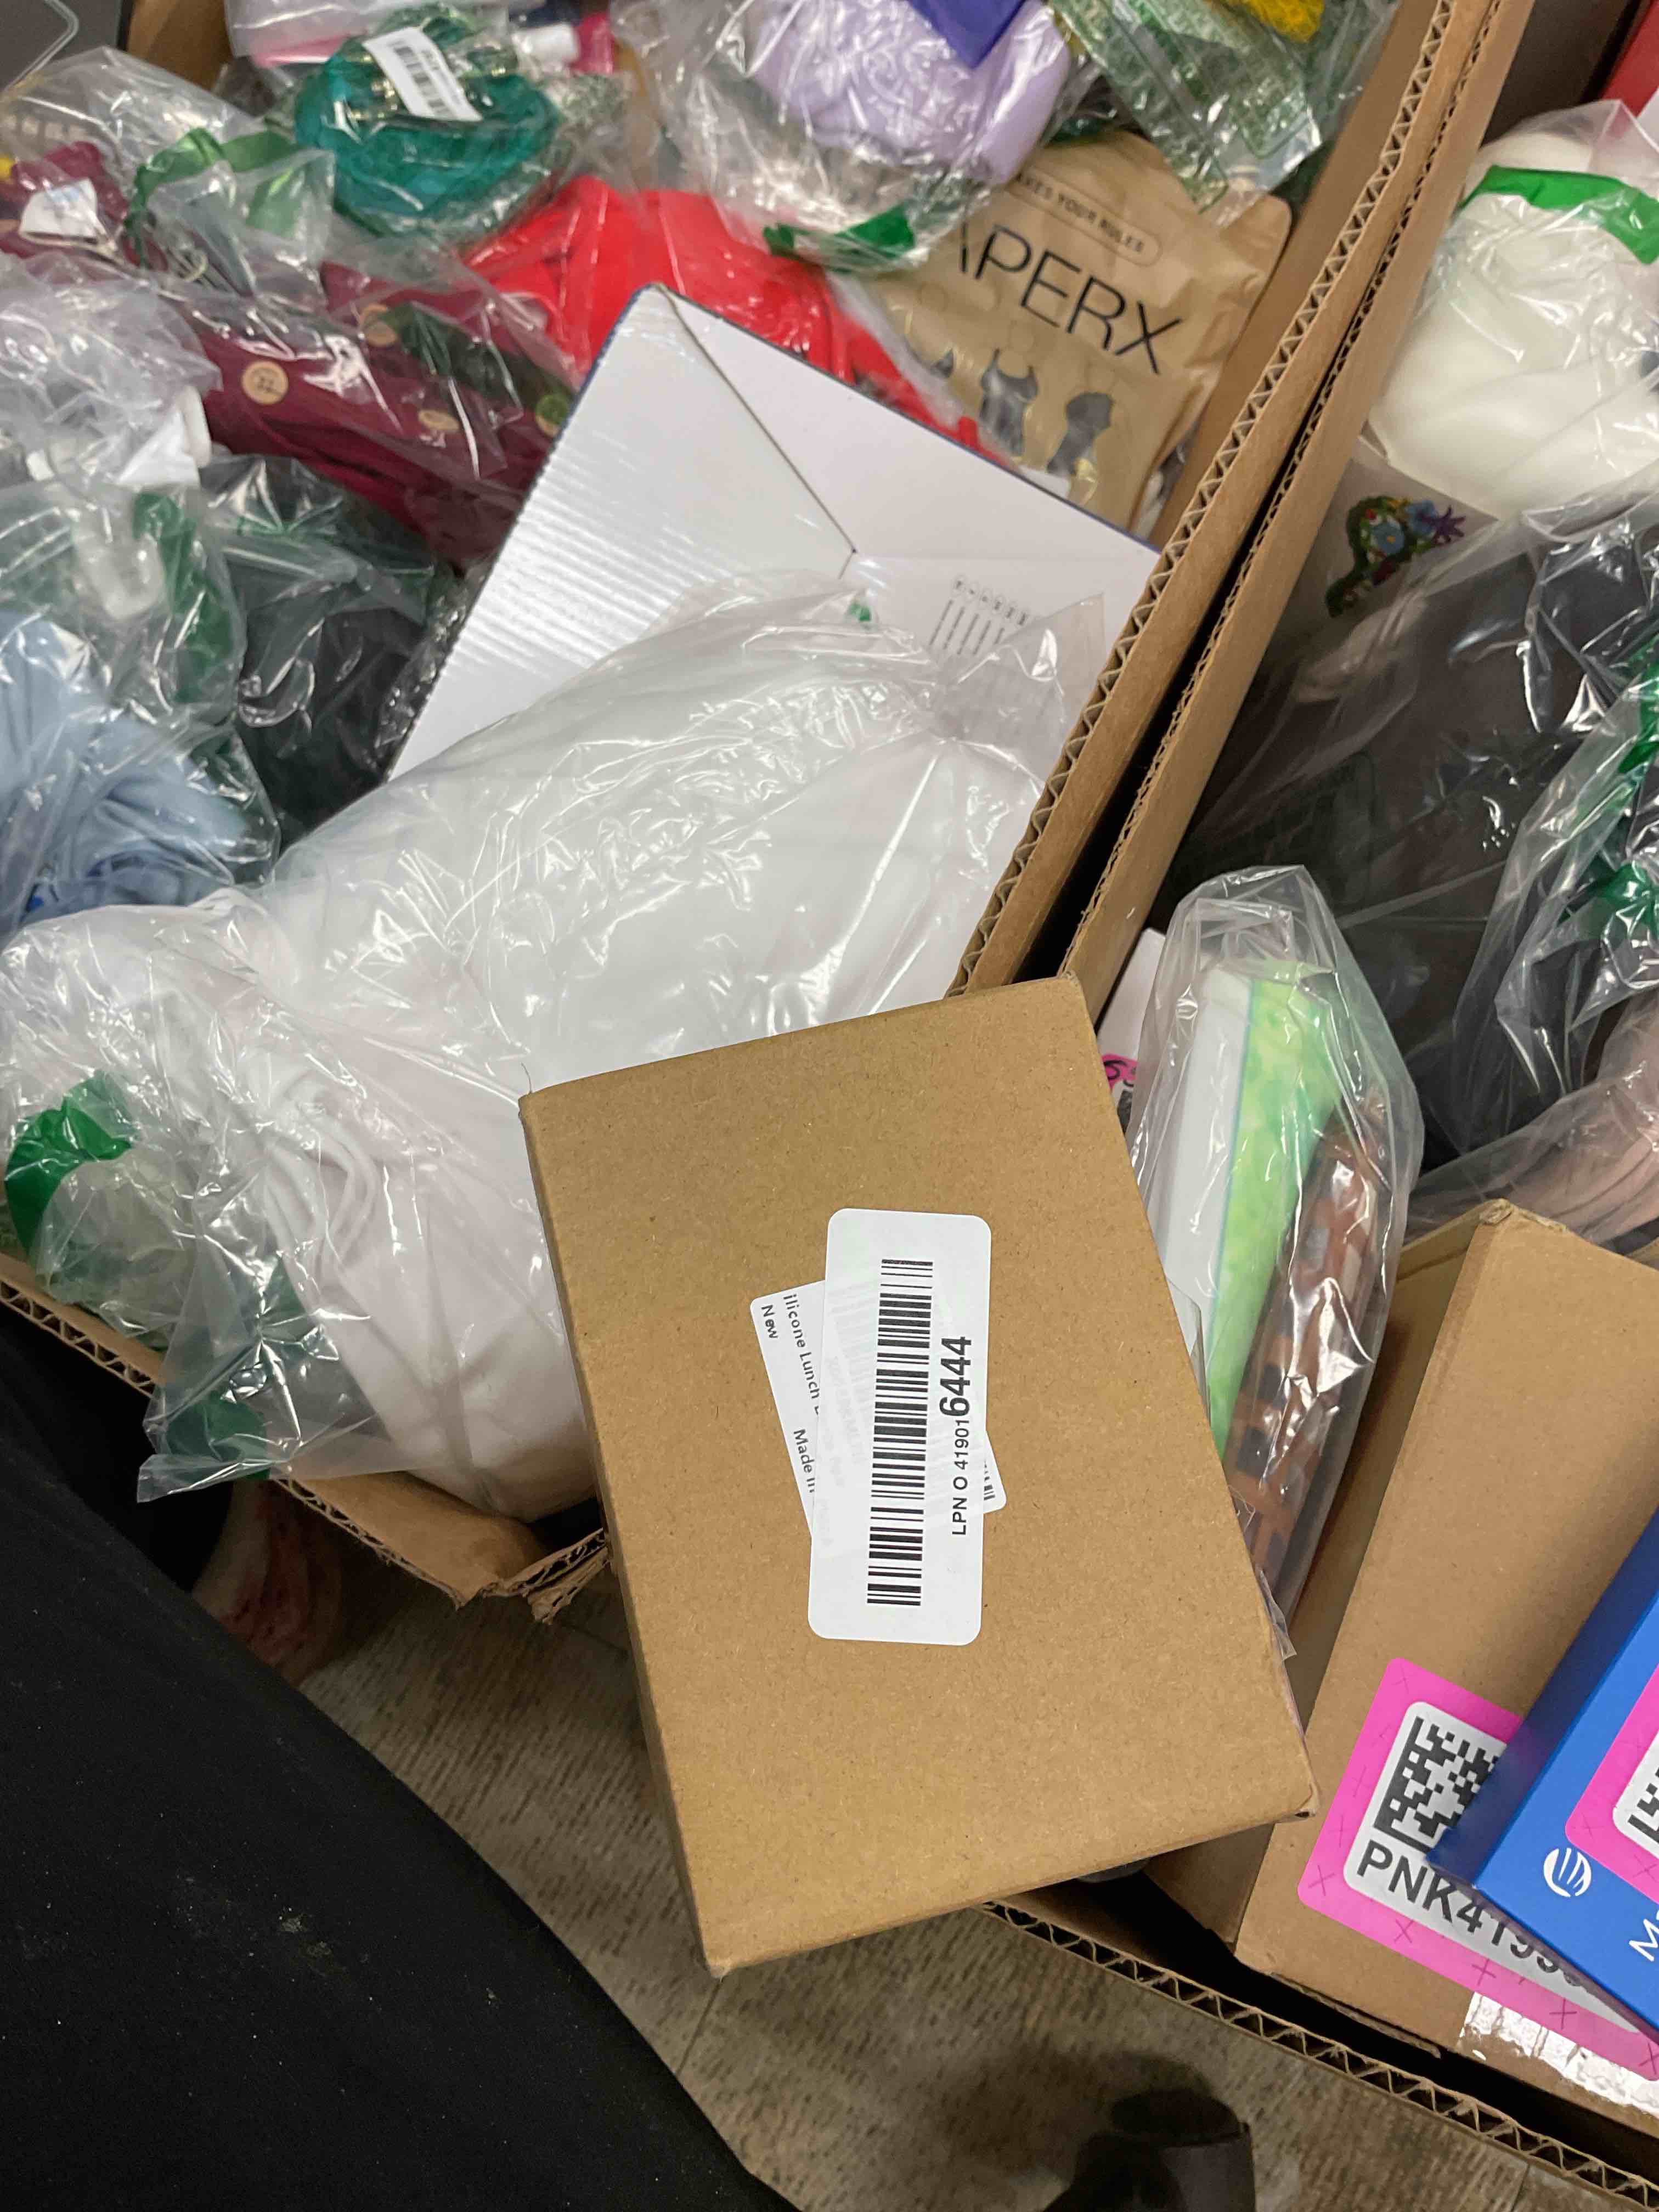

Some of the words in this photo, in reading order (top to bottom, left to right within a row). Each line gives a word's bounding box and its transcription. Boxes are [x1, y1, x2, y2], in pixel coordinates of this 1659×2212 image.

[761, 1304, 778, 1339] New
[783, 1294, 806, 1348] ilicone
[799, 1351, 821, 1399] Lunch
[793, 1428, 815, 1473] Made
[952, 1497, 967, 1536] LPN
